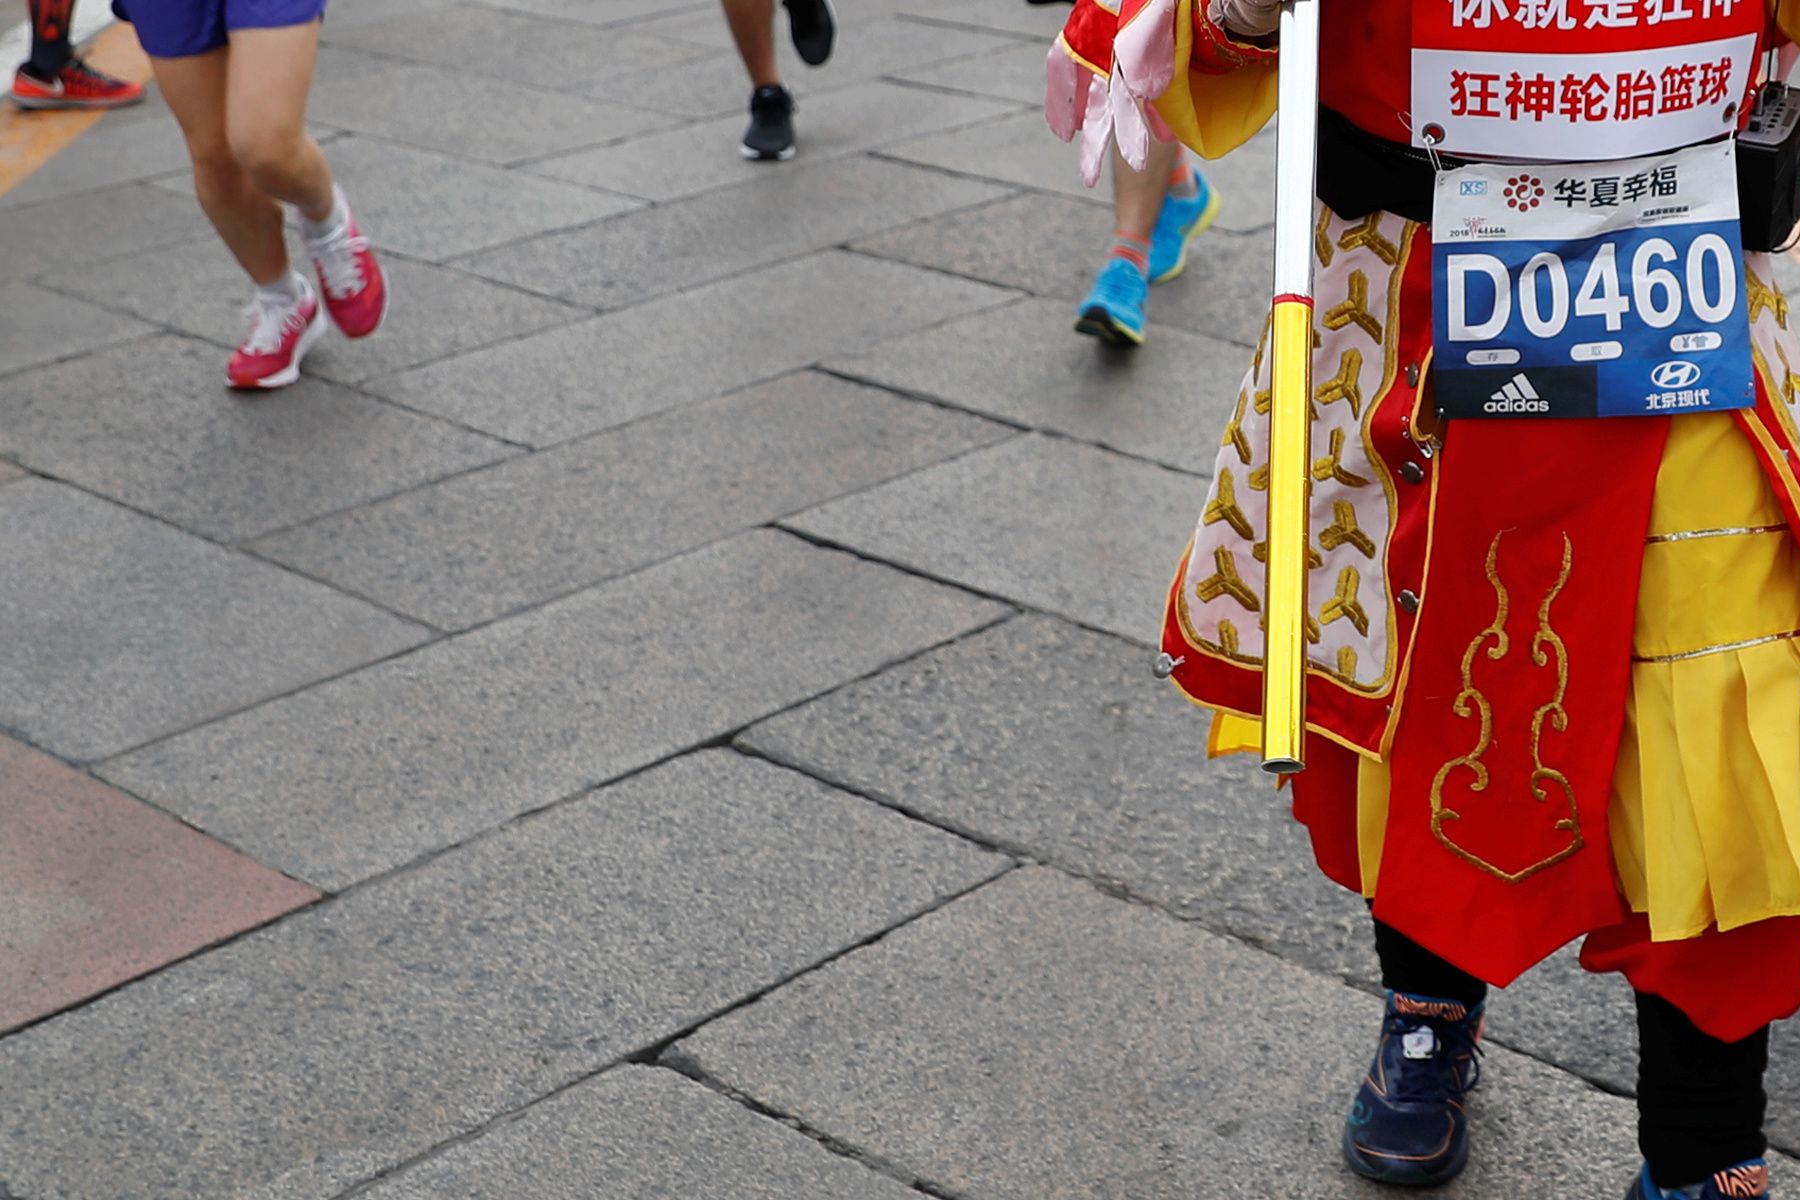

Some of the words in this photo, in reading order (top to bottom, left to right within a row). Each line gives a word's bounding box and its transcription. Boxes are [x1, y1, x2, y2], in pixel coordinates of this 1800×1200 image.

[1450, 56, 1733, 124] 狂神轮胎篮球
[1554, 164, 1678, 209] 华夏幸福
[1447, 233, 1737, 342] D0460
[1483, 399, 1550, 414] adidas
[1645, 389, 1711, 410] 北京现代
